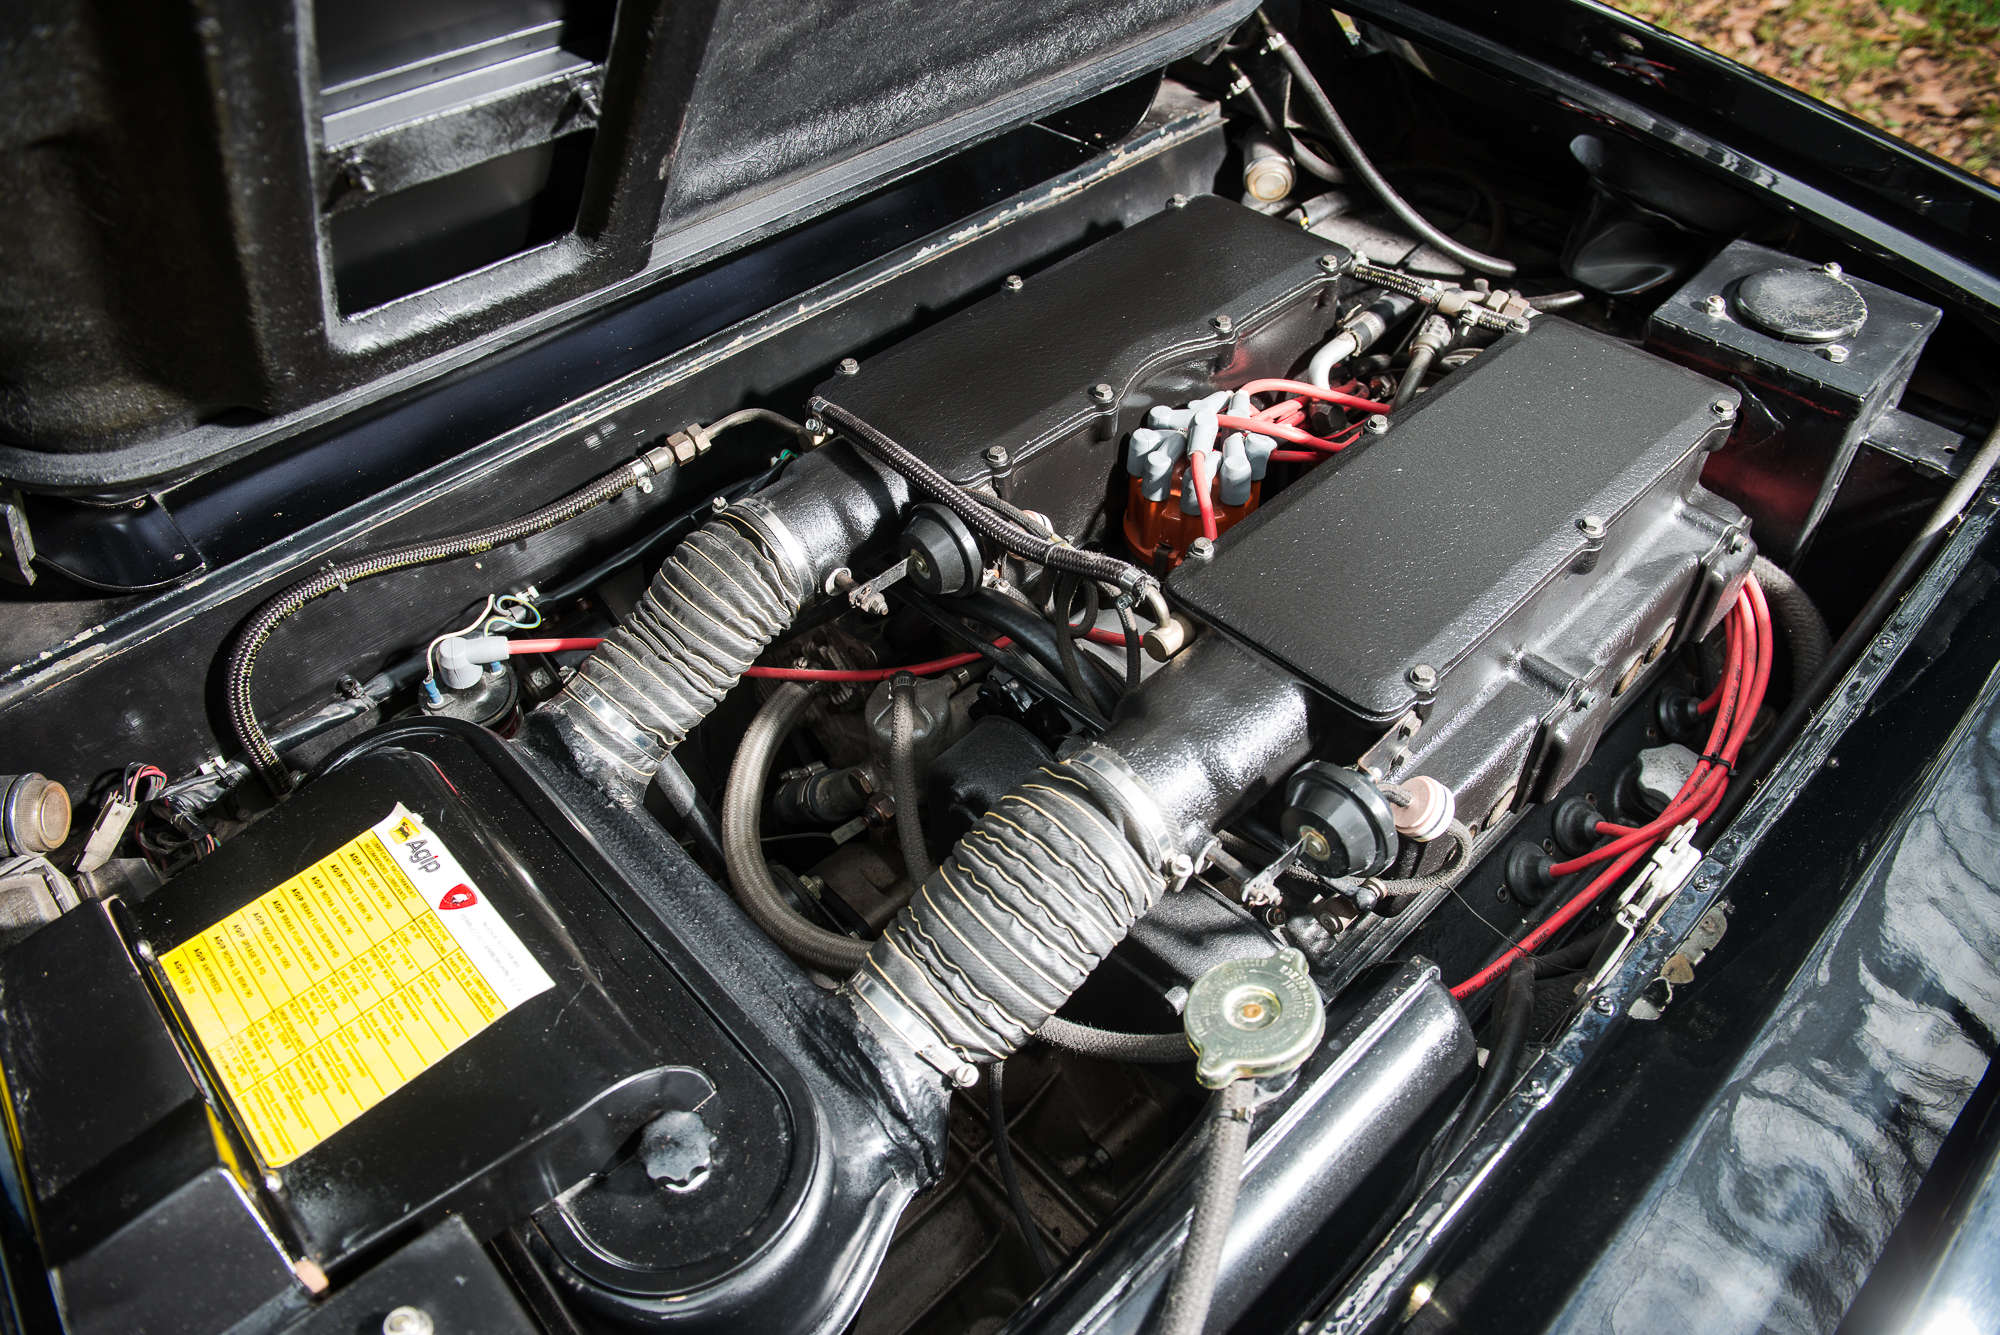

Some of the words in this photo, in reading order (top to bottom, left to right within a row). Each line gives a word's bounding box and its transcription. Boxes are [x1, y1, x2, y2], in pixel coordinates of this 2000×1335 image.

[348, 851, 362, 867] AGIP
[405, 838, 441, 873] Agip
[329, 863, 343, 879] AGIP
[309, 875, 323, 890] AGIP
[289, 887, 304, 903] AGIP
[271, 899, 284, 915] AGIP
[251, 911, 265, 927] AGIP
[231, 923, 245, 939] AGIP
[212, 935, 225, 951] AGIP
[192, 947, 205, 964] AGIP
[172, 960, 185, 976] AGIP
